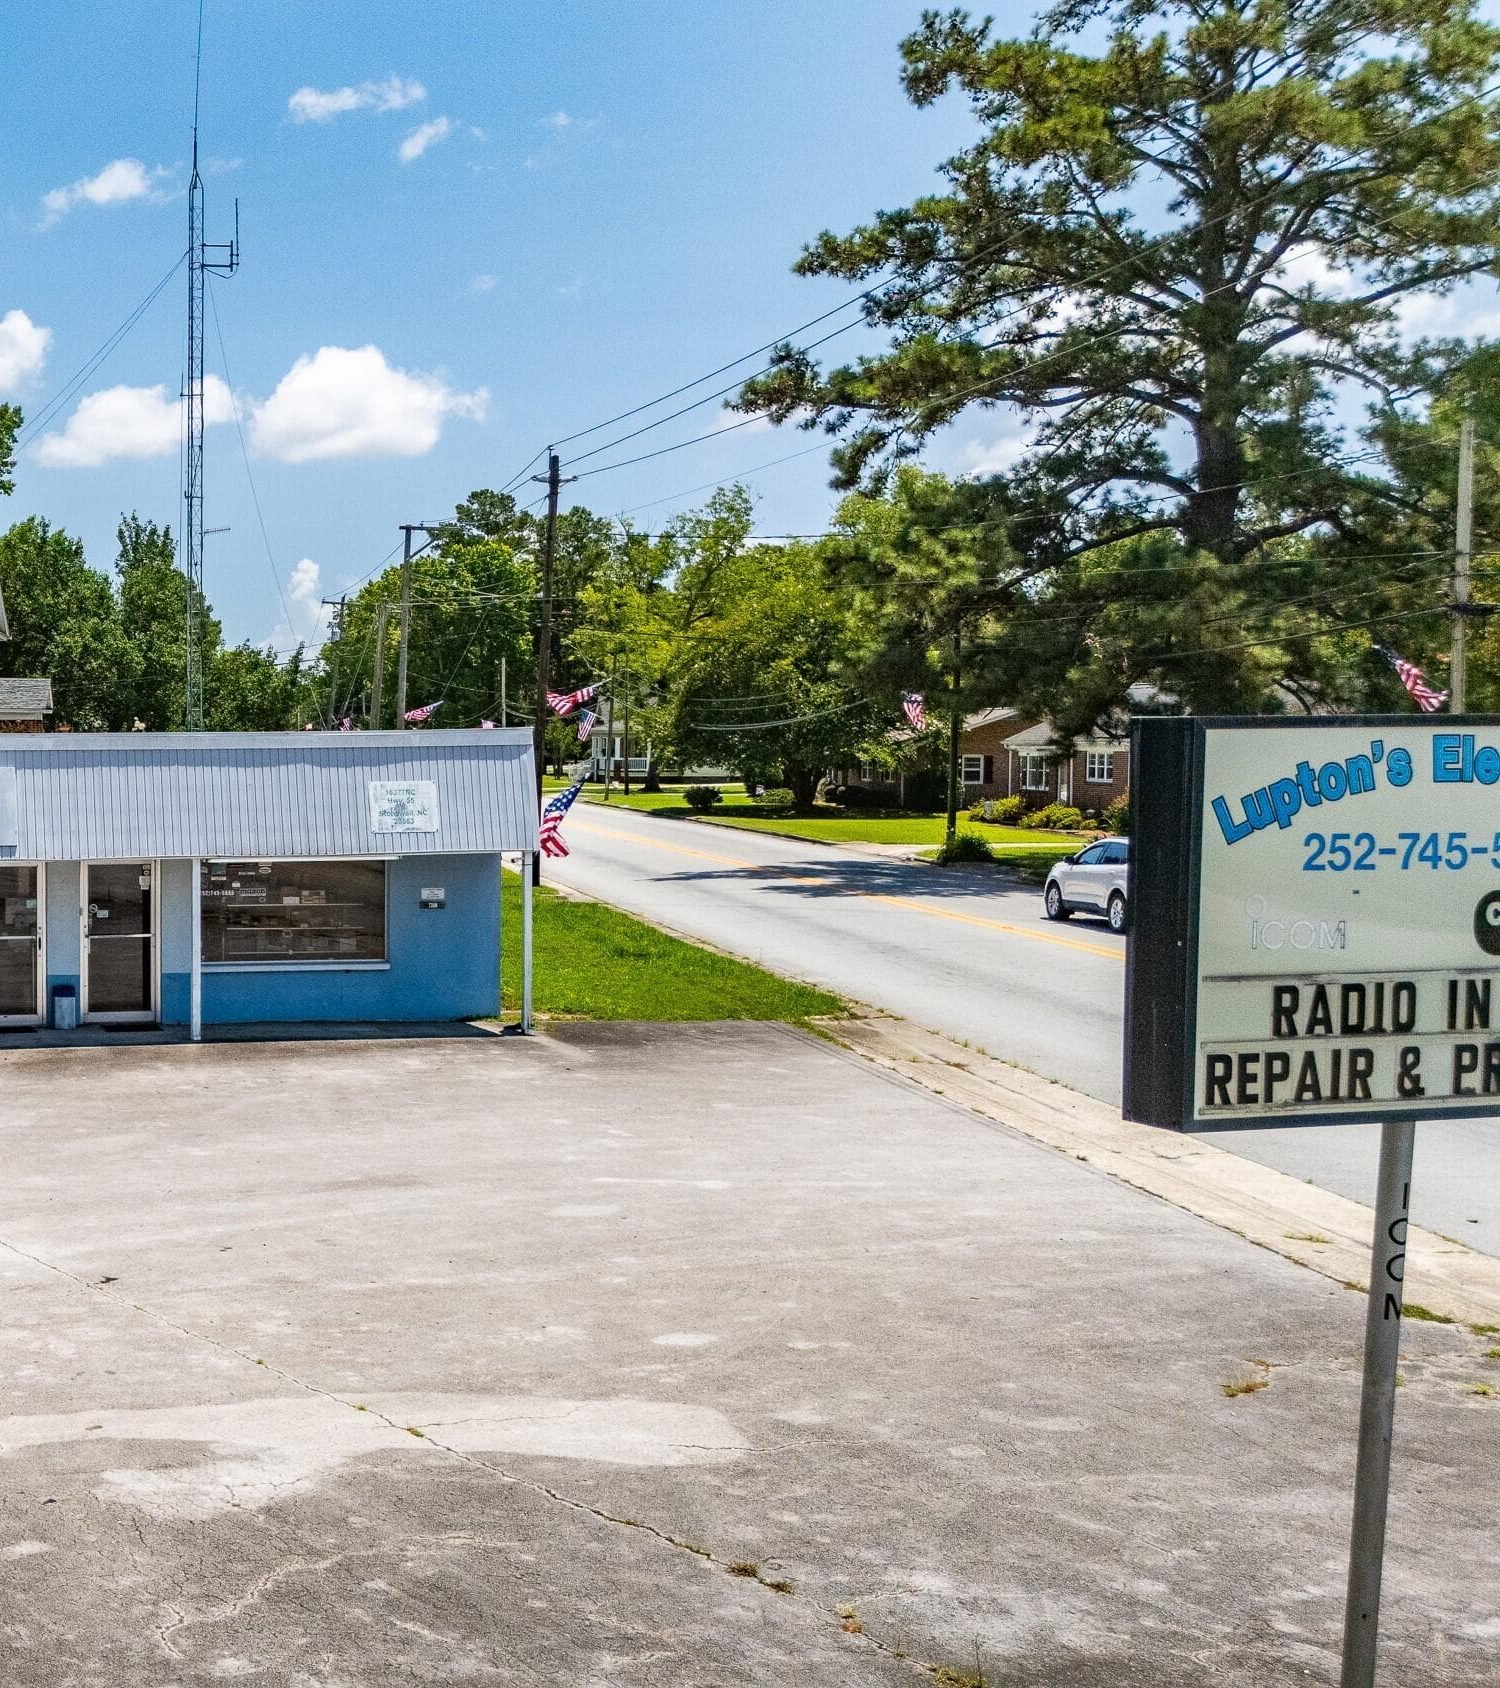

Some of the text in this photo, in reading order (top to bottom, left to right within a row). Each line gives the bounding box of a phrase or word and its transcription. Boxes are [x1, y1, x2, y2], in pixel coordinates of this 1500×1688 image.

[1211, 740, 1413, 845] Lupton's
[1272, 979, 1491, 1036] RADIO IN
[1205, 1048, 1375, 1105] REPAIR
[1397, 1046, 1425, 1097] &
